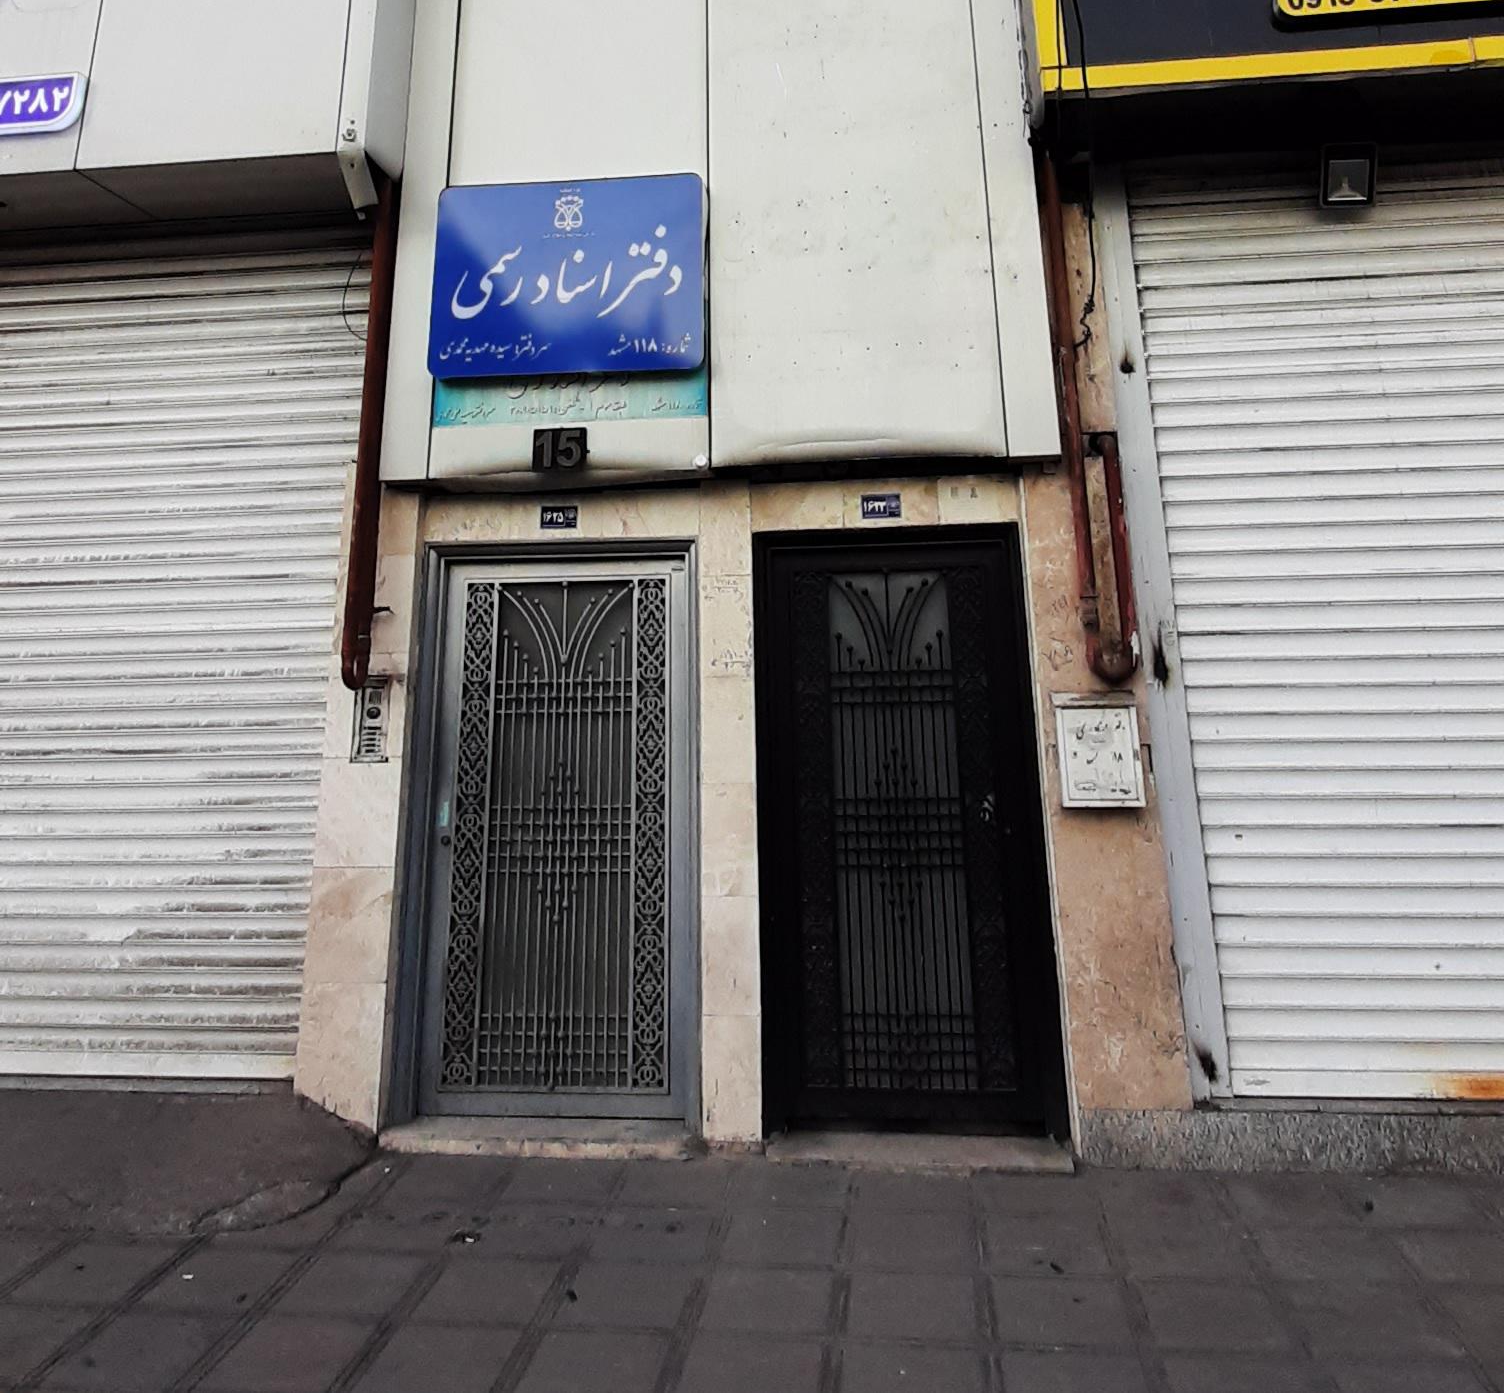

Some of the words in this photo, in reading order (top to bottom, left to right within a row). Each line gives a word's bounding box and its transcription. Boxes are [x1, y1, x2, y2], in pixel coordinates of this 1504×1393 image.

[450, 244, 523, 320] رسمی
[530, 248, 613, 306] اسناد
[596, 223, 683, 319] دفتر
[633, 336, 658, 354] ۱۱۸
[535, 430, 582, 468] 15
